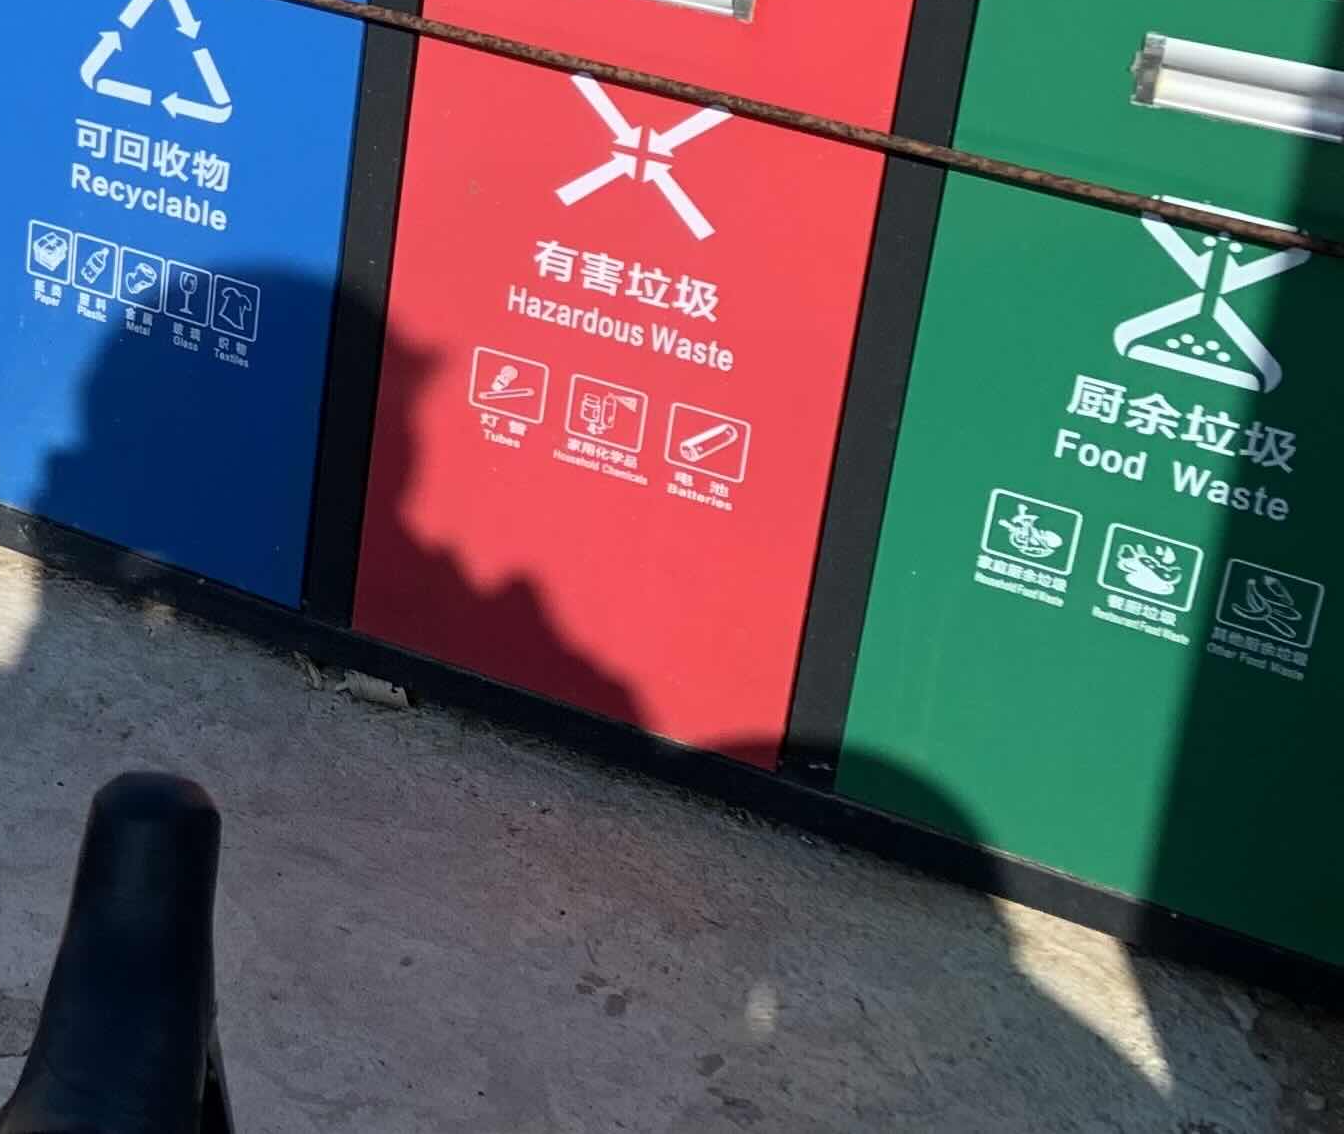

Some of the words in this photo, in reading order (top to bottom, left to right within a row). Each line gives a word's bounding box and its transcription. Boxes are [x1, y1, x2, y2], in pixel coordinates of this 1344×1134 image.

[75, 118, 231, 193] 可回收物
[71, 164, 228, 231] Recyclable
[534, 240, 719, 322] 有害垃圾
[507, 285, 644, 347] Hazardous
[651, 323, 734, 371] Waste
[483, 429, 521, 449] Tubes
[1065, 374, 1297, 473] 厨余垃圾
[666, 482, 733, 512] Batteries
[1054, 428, 1147, 481] Food
[1172, 461, 1290, 521] Waste
